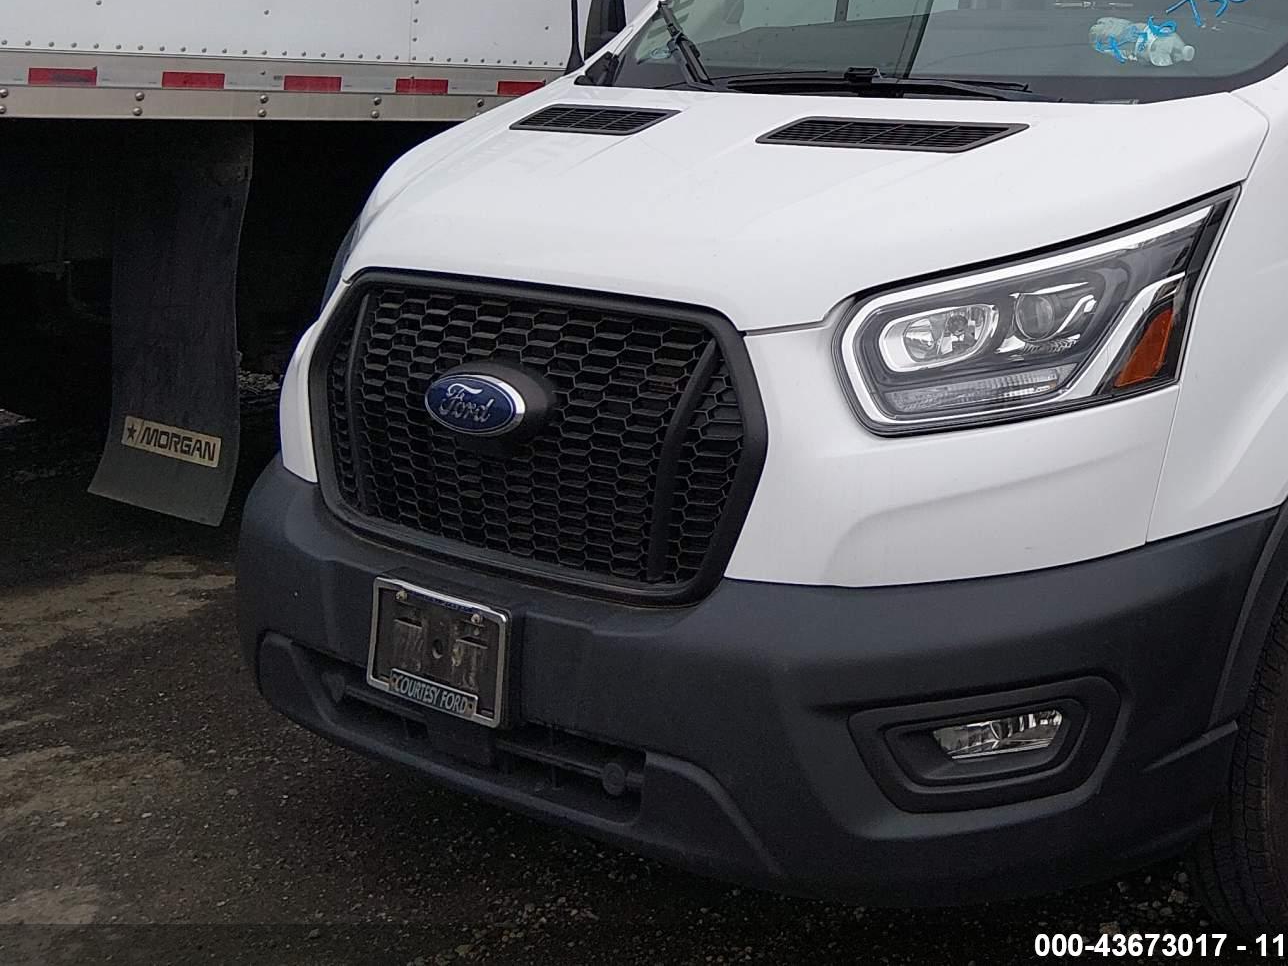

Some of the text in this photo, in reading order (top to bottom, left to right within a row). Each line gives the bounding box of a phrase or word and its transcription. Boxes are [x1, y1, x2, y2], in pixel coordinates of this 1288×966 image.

[439, 382, 495, 423] Ford
[140, 426, 217, 462] MORGAN
[394, 675, 468, 714] COURTESY FORD
